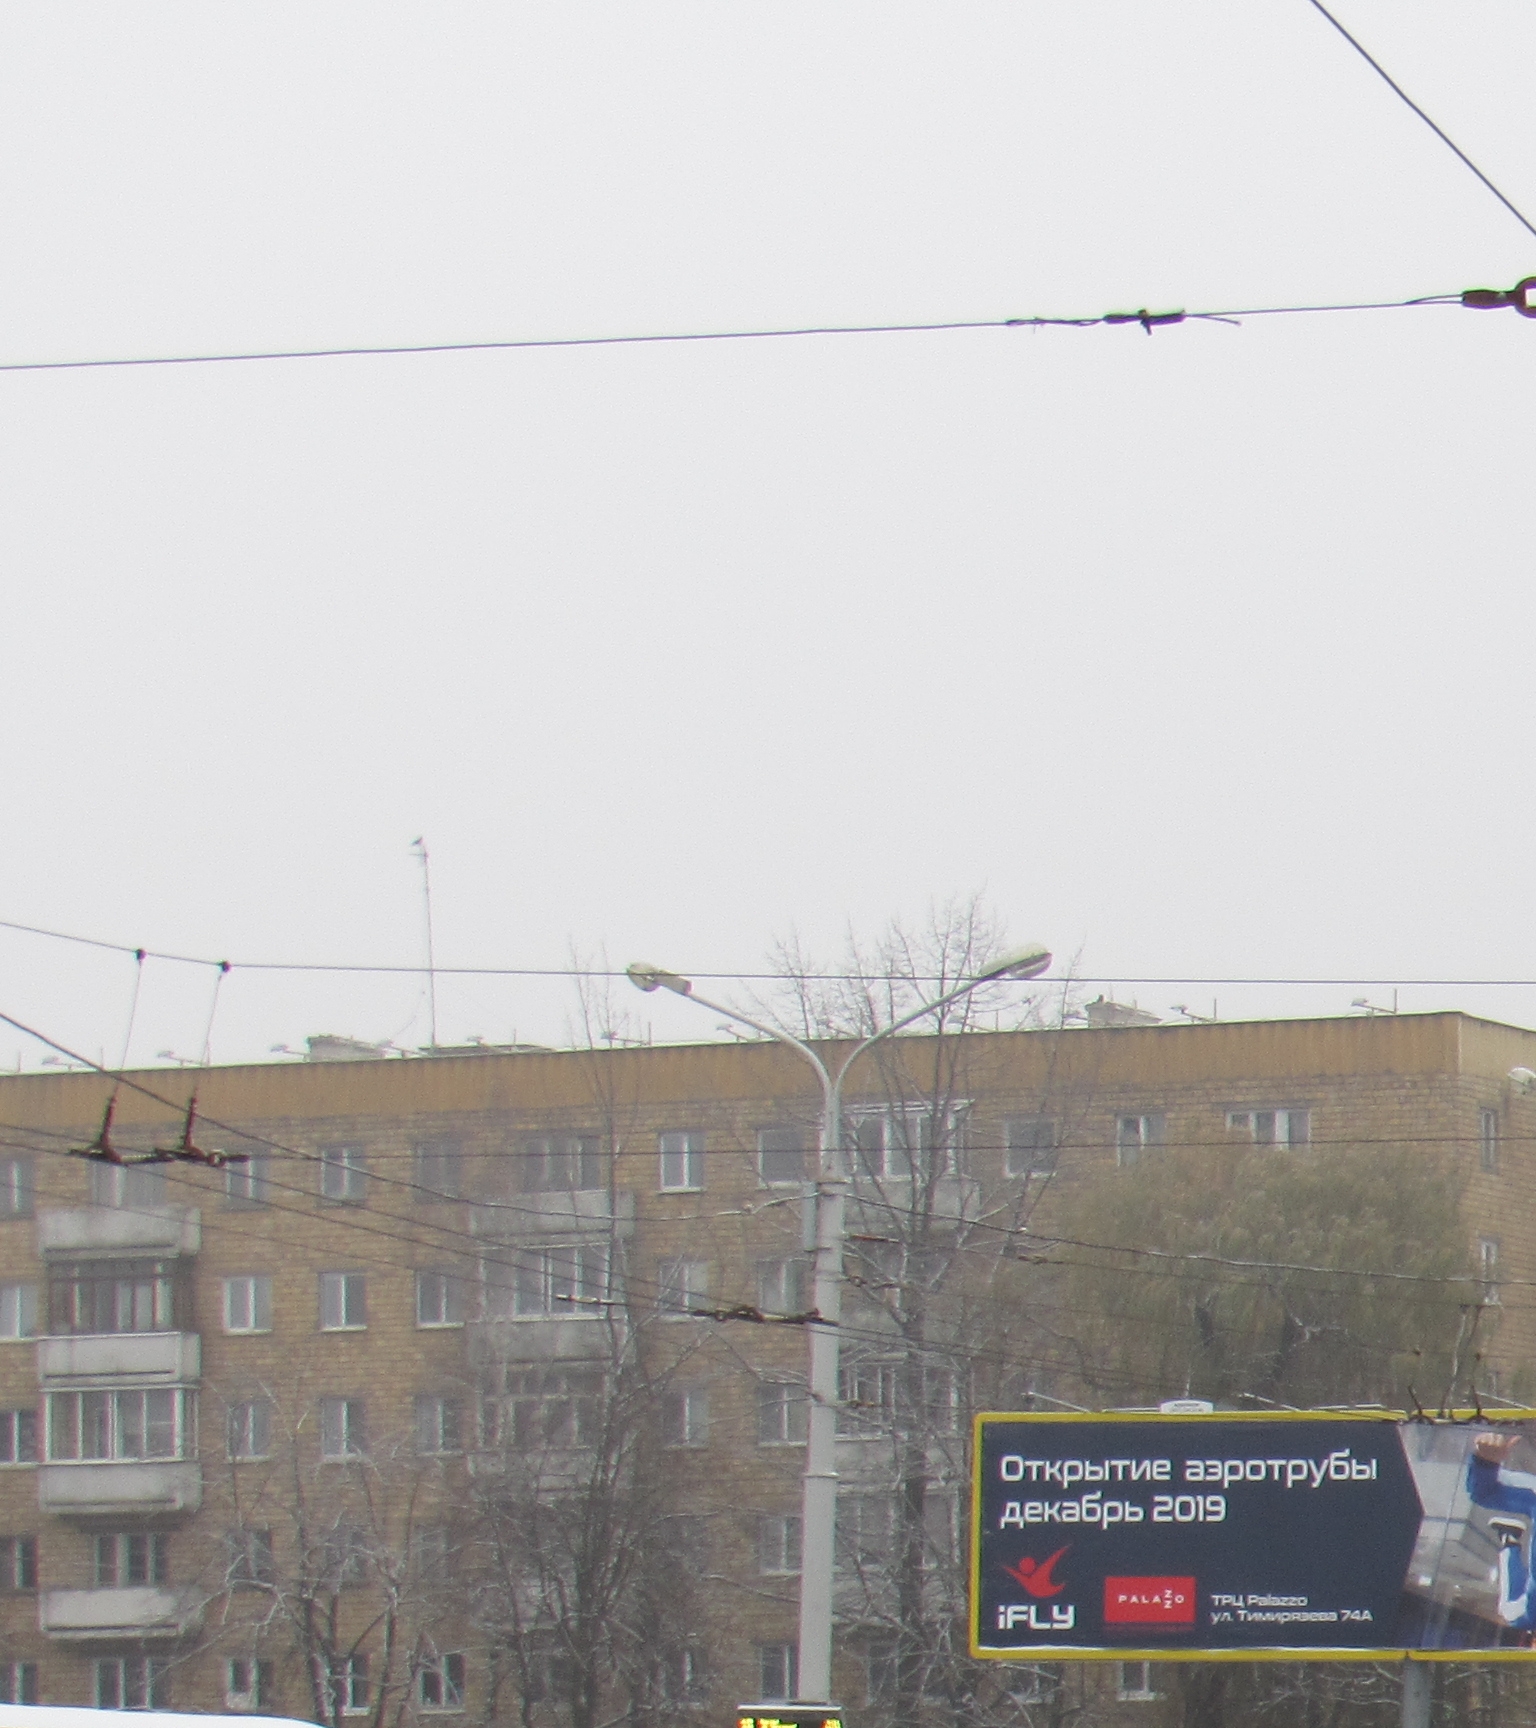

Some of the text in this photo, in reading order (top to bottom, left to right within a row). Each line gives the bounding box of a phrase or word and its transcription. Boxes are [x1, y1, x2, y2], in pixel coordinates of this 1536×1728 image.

[1000, 1448, 1378, 1488] Открытие аэротрубы
[1000, 1491, 1228, 1530] декабрь 2019
[1117, 1589, 1186, 1609] PALAZZO
[1211, 1594, 1308, 1609] ТРЦ Palazzo
[997, 1605, 1076, 1630] iFLY
[1210, 1611, 1234, 1625] ул.
[1237, 1609, 1338, 1624] Тимирязева
